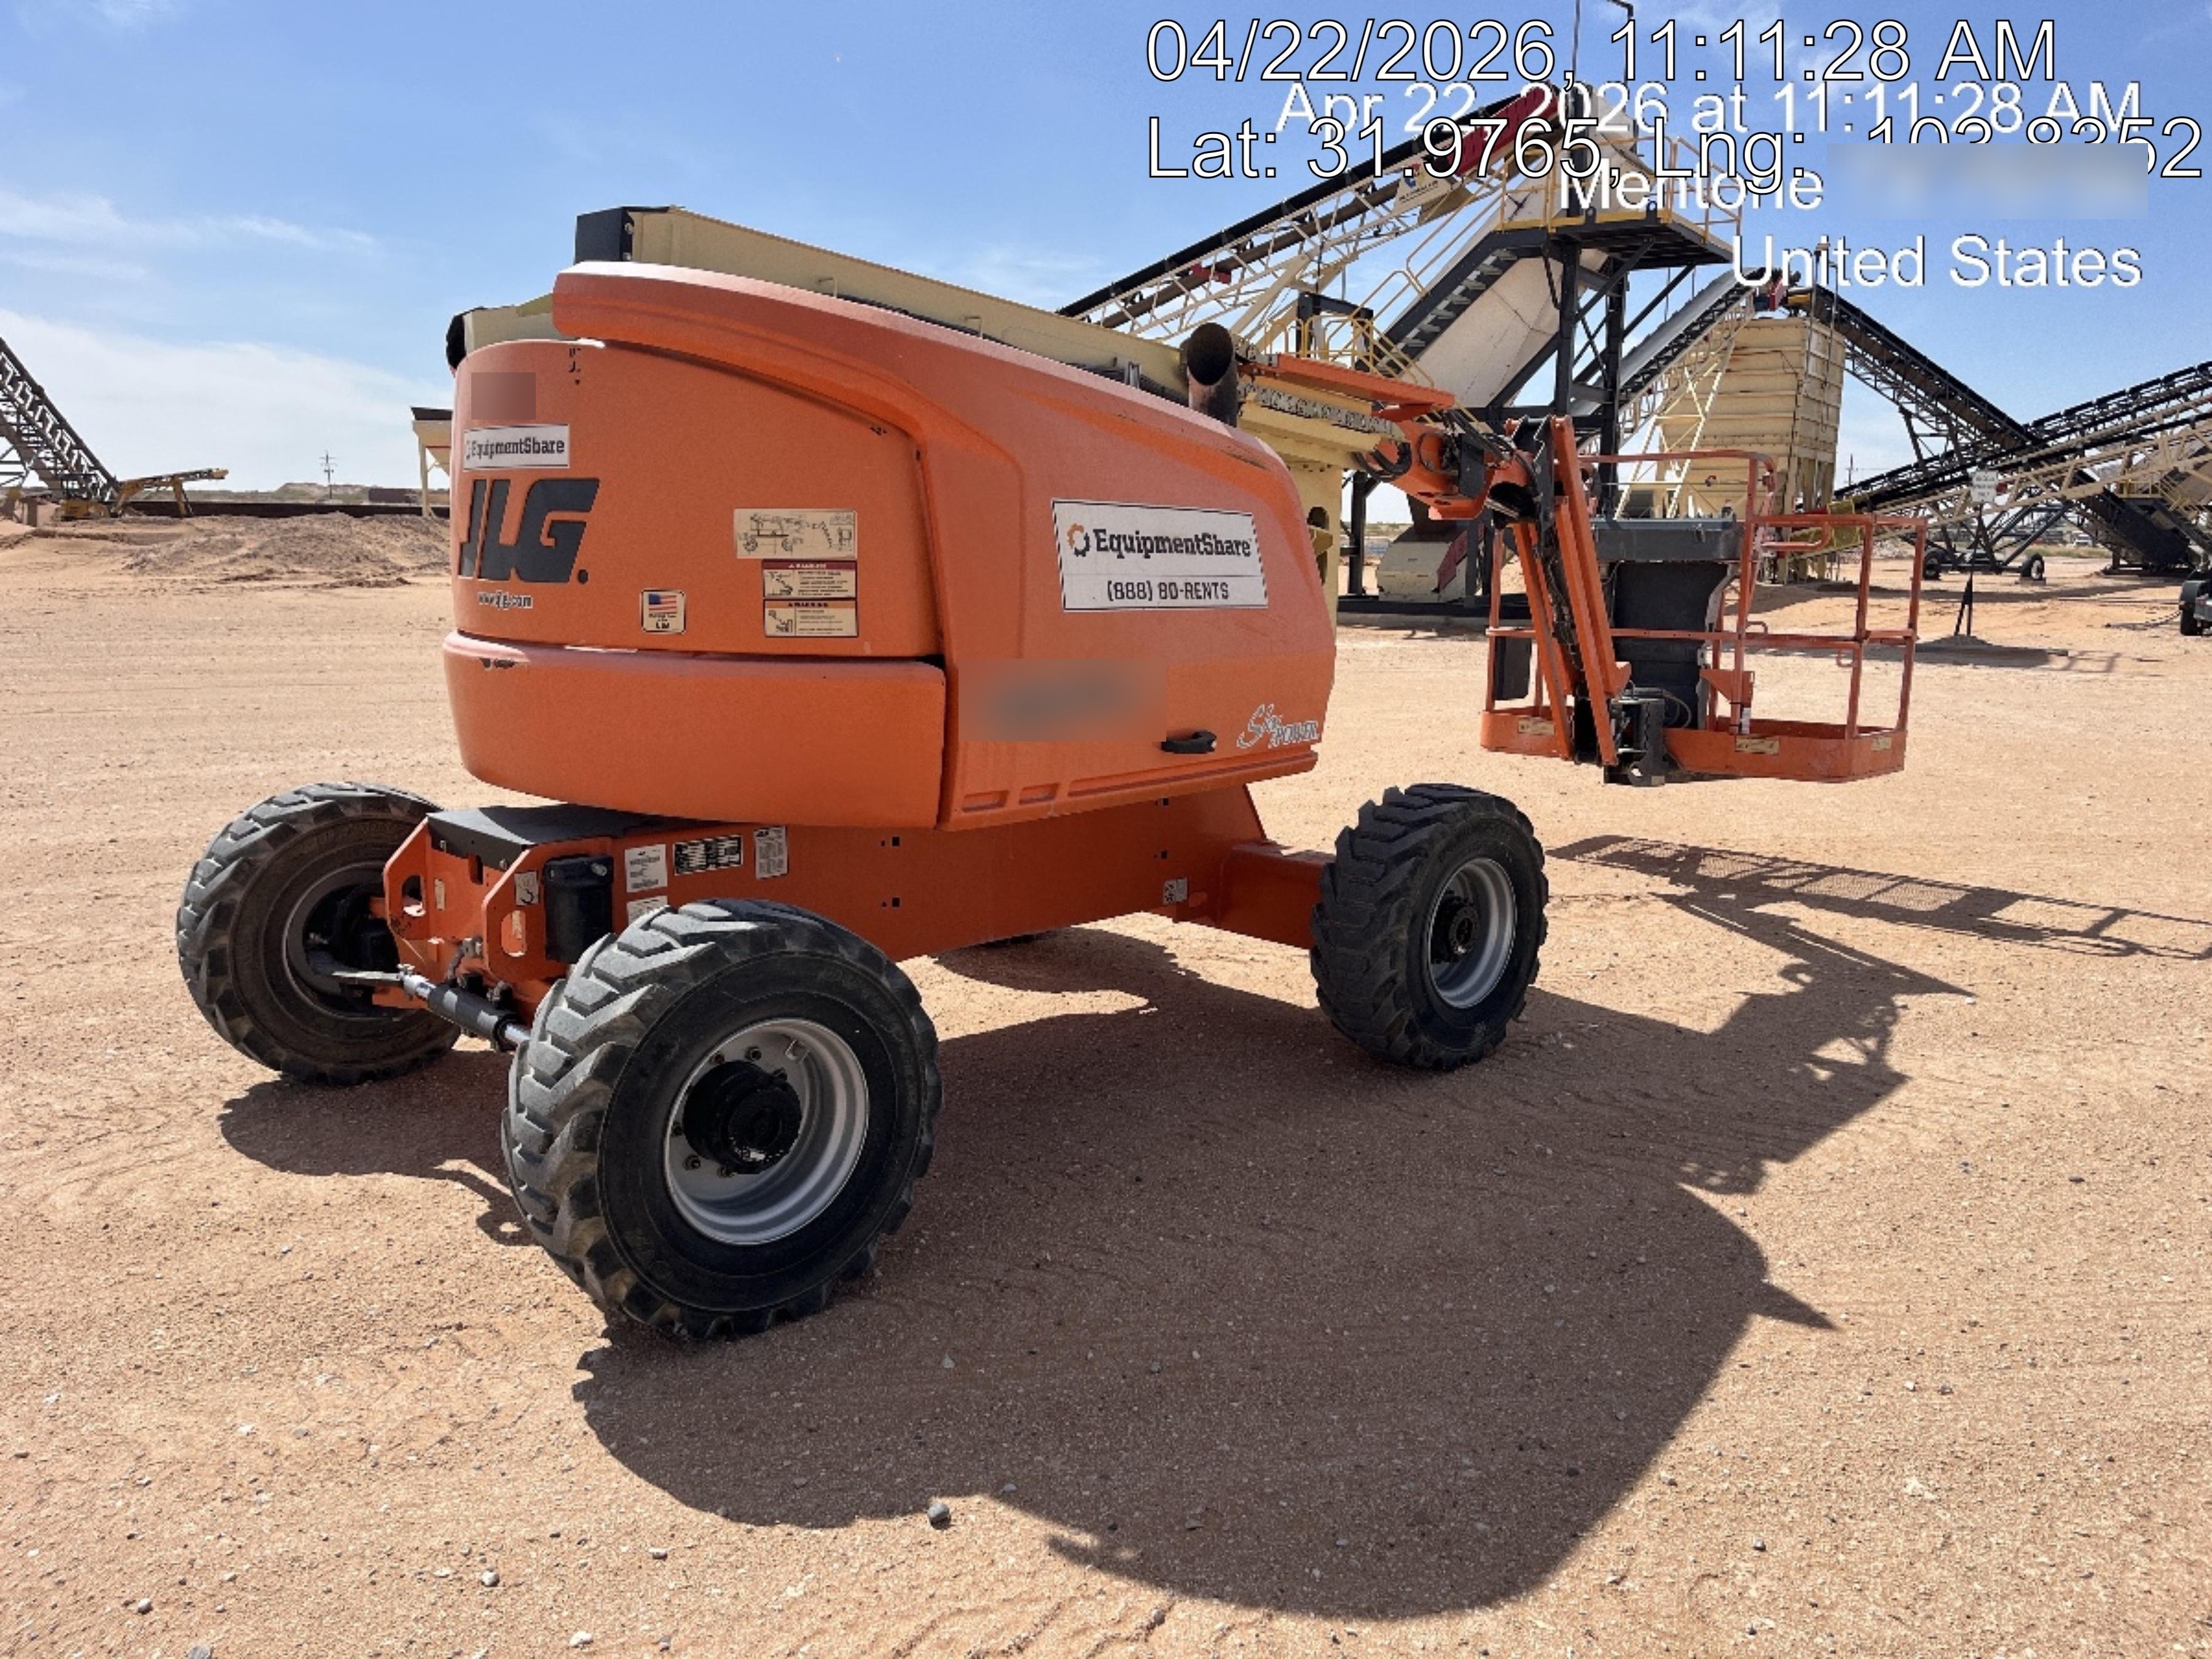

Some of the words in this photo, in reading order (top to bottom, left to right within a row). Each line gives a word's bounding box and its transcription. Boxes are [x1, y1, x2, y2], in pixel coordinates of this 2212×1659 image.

[458, 479, 600, 584] JLG
[1093, 528, 1252, 559] EquipmentShare
[1107, 580, 1153, 602] (888)
[1159, 582, 1230, 600] 80-RENTS
